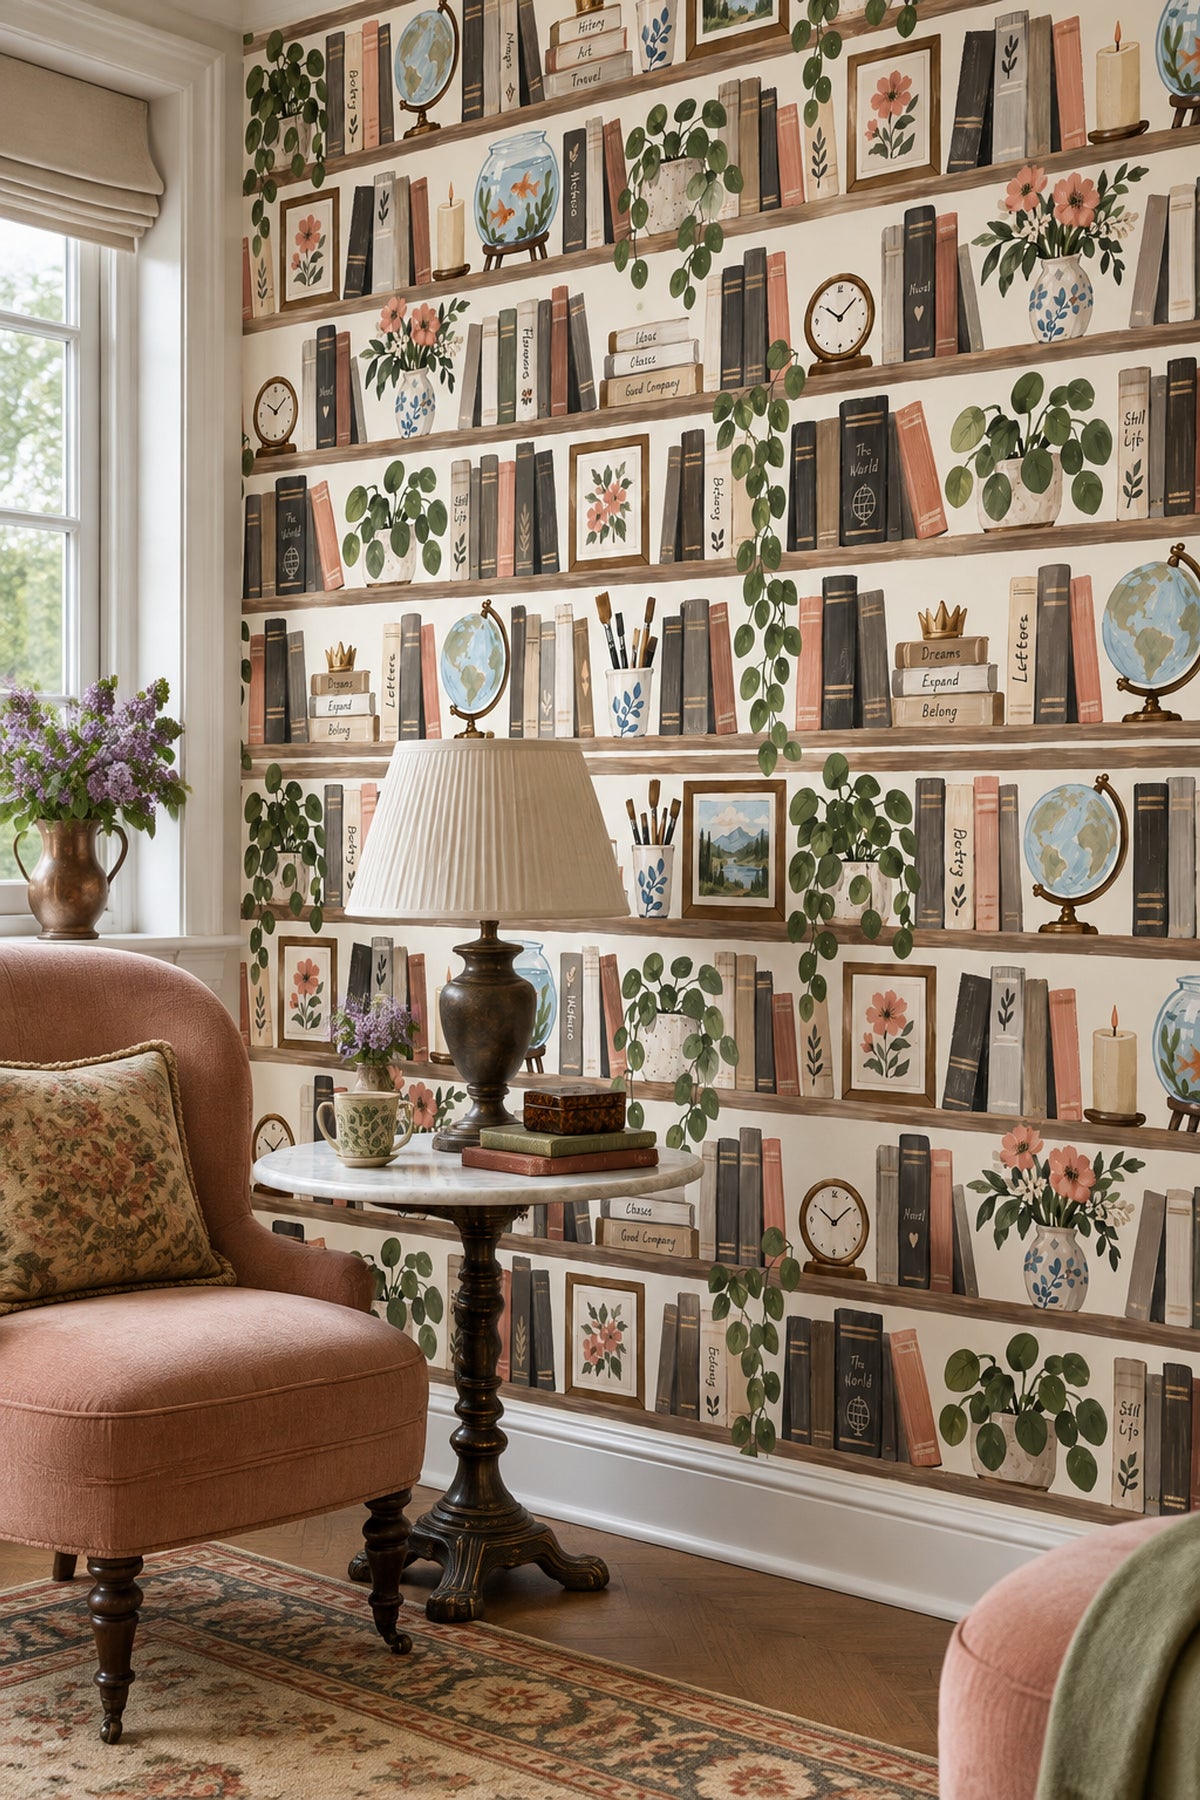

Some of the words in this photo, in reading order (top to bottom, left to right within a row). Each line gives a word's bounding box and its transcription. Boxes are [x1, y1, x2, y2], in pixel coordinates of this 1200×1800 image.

[921, 646, 961, 660] Dreams
[922, 671, 960, 693] Expand
[922, 703, 958, 724] Belong
